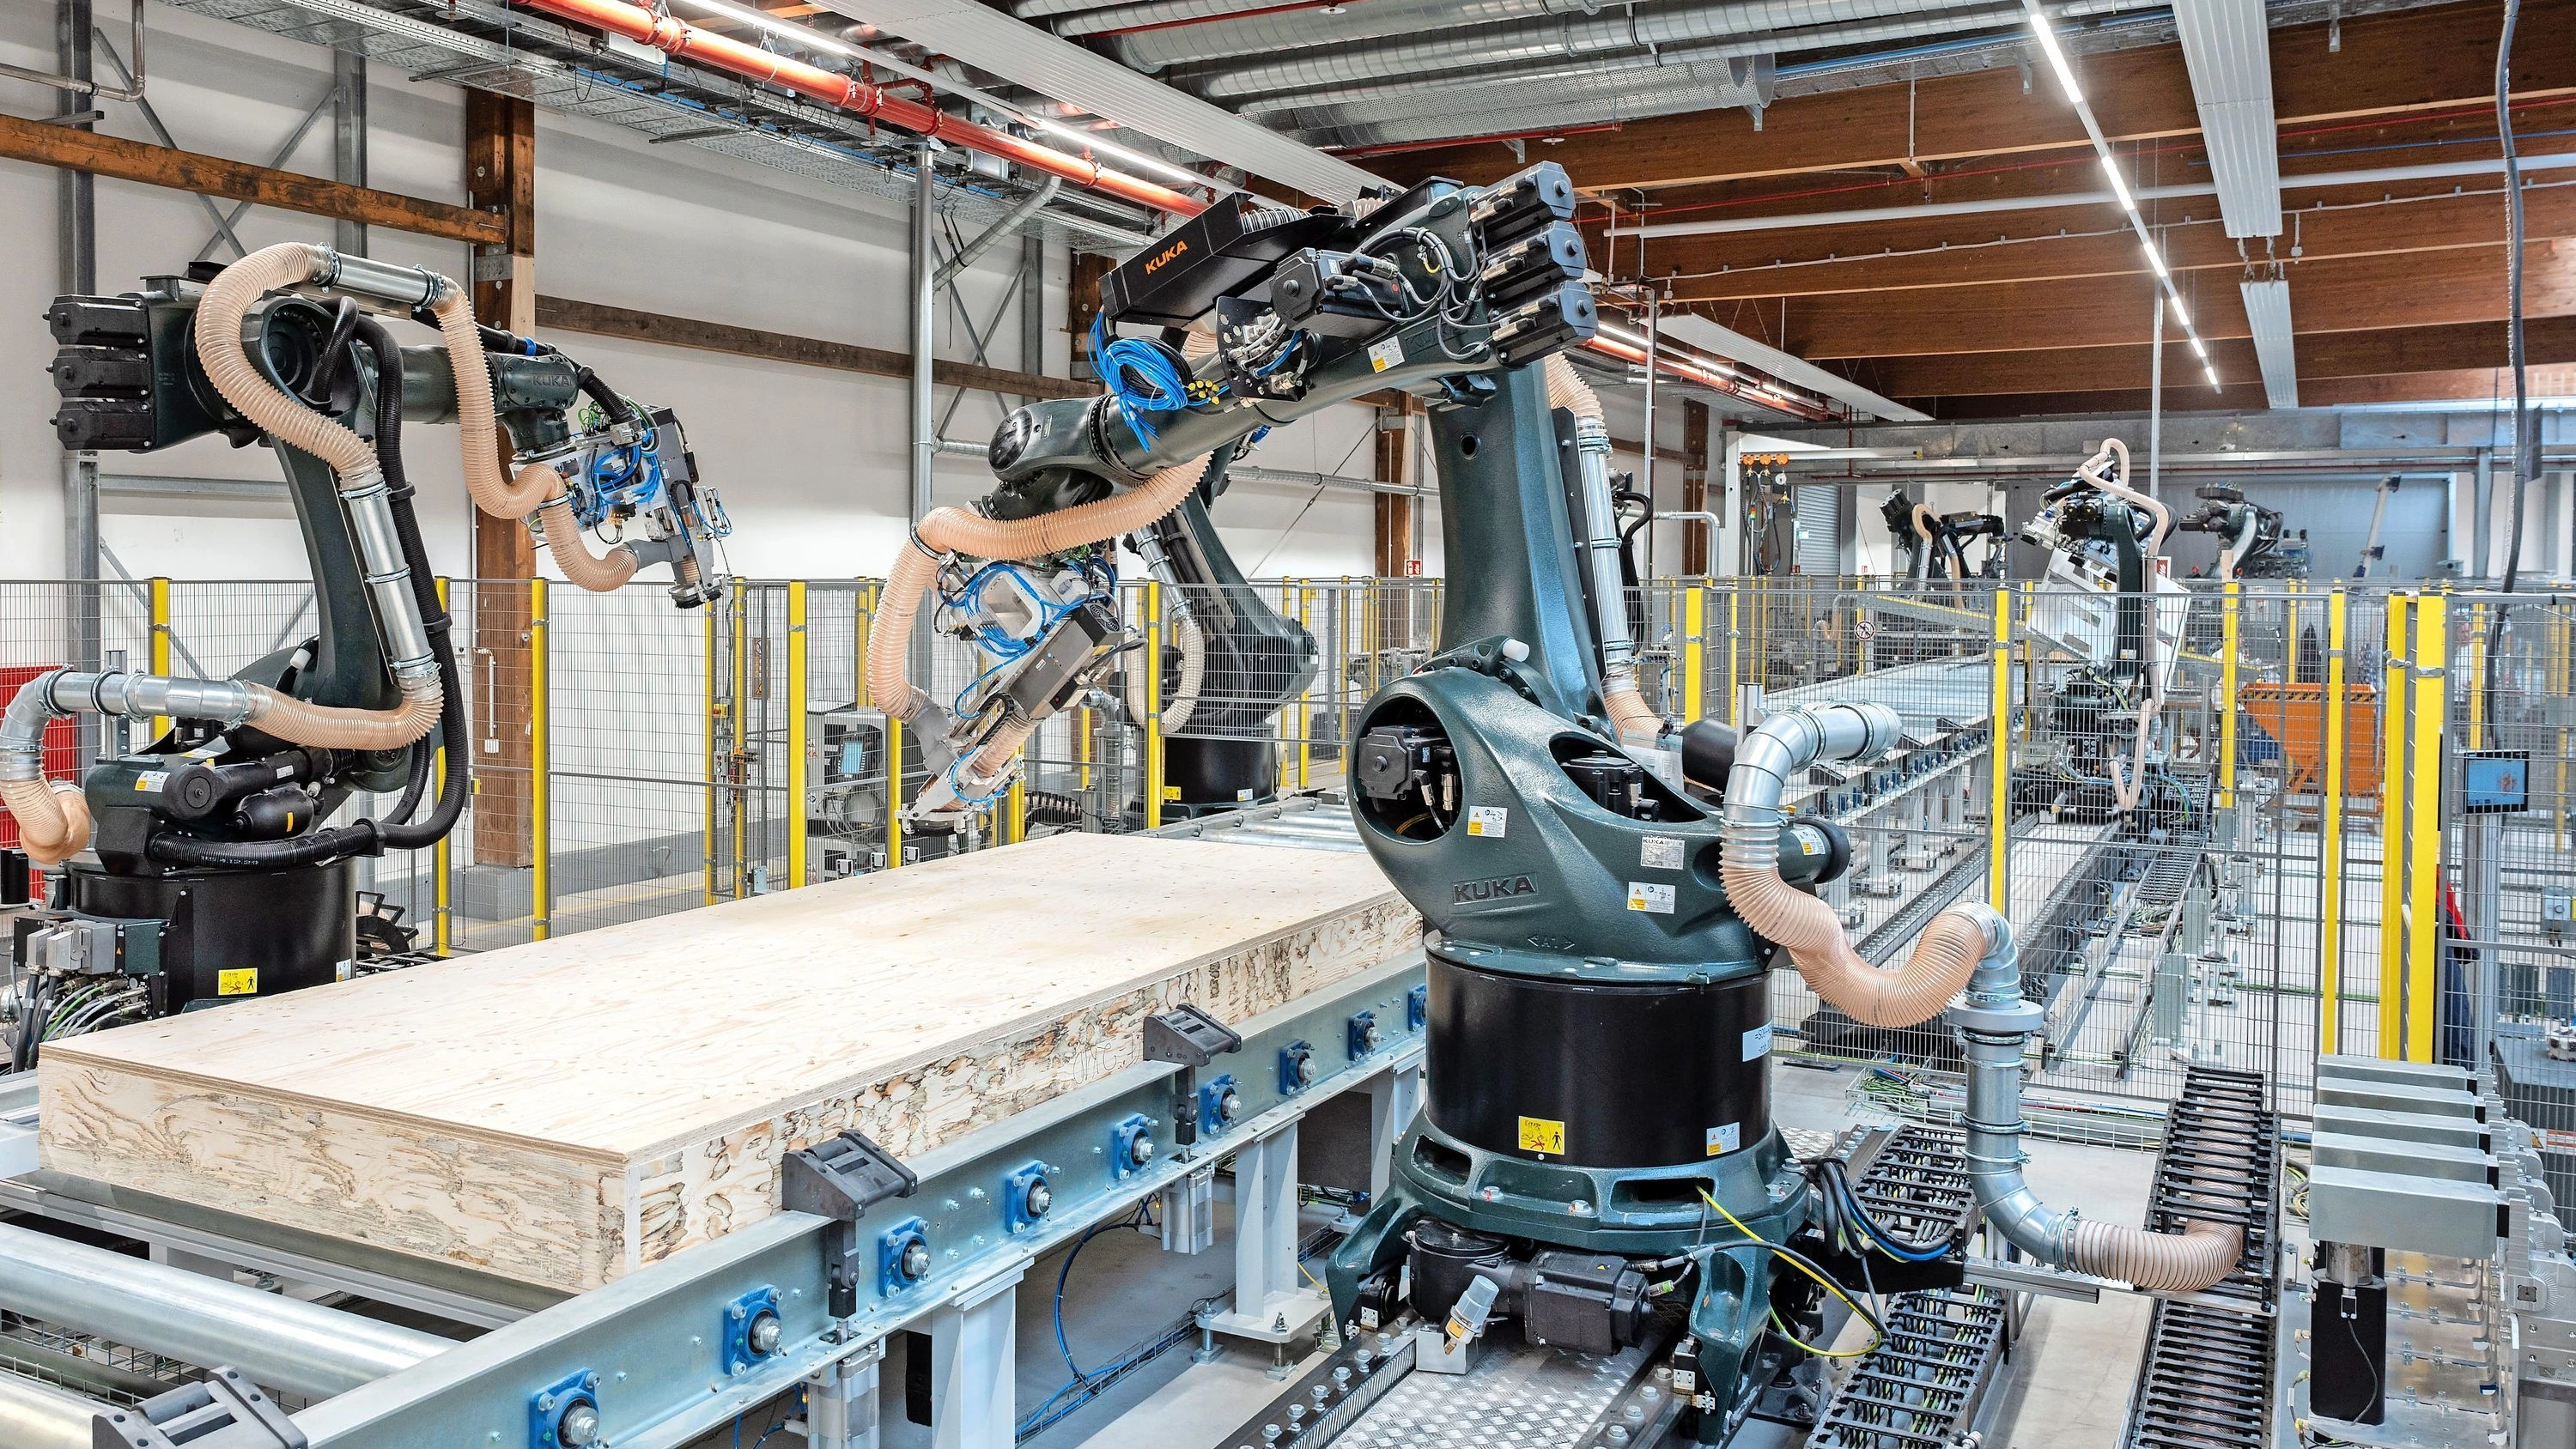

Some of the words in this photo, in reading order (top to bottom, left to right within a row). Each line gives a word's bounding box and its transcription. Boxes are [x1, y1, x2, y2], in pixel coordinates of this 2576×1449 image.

[1145, 240, 1188, 275] KUKA
[532, 374, 570, 386] KUKA
[1454, 876, 1536, 901] KUKA
